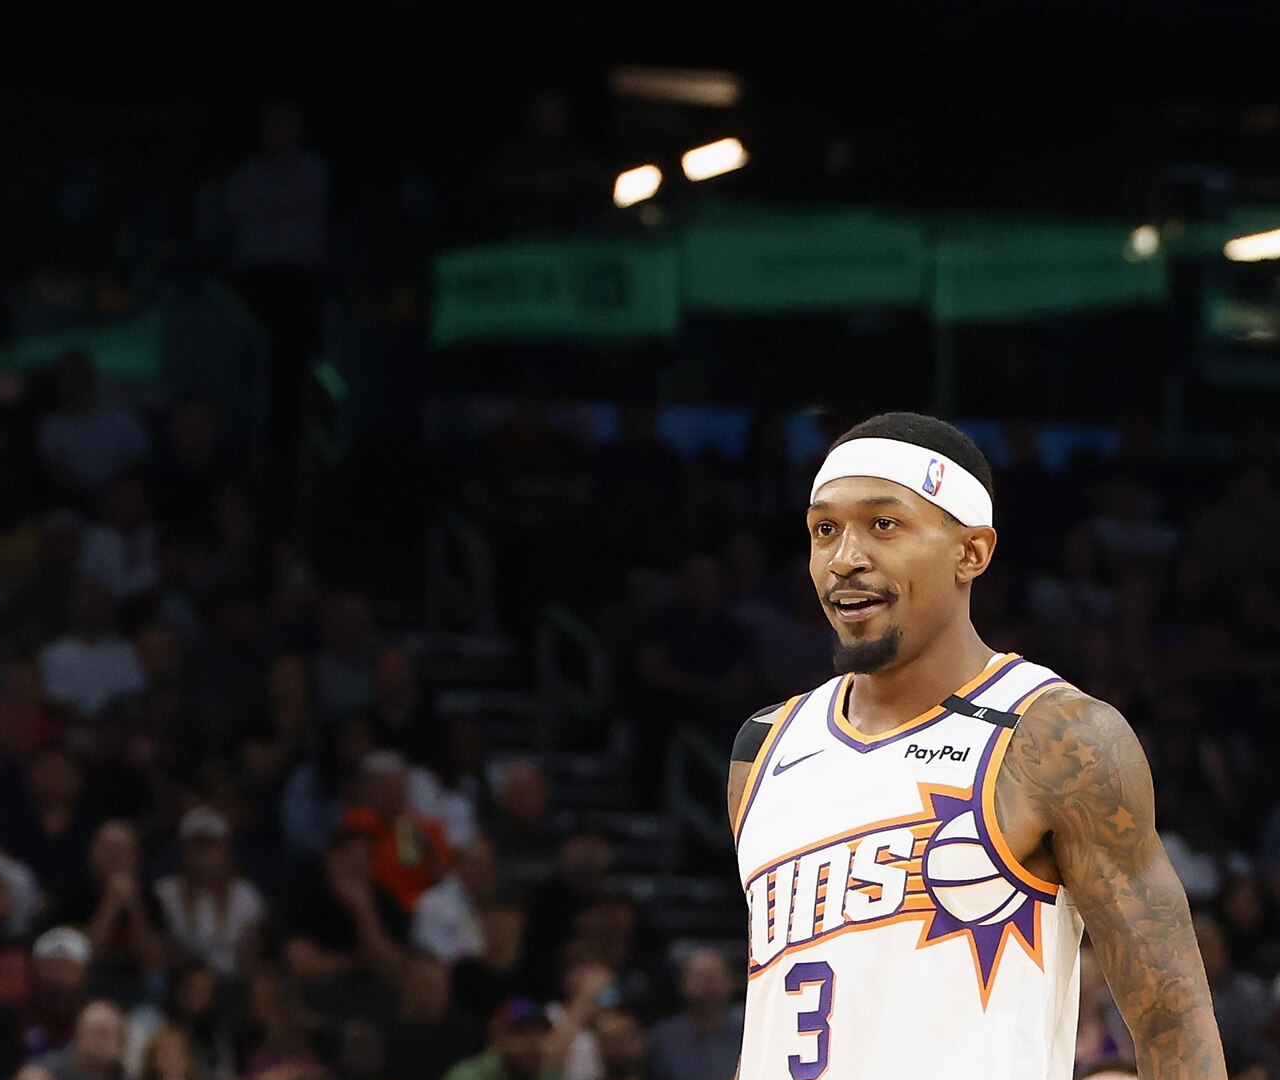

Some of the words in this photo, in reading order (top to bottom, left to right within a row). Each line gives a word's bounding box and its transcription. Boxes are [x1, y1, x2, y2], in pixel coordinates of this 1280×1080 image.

[972, 707, 988, 719] AL
[904, 744, 971, 764] PayPal
[746, 827, 916, 967] UNS
